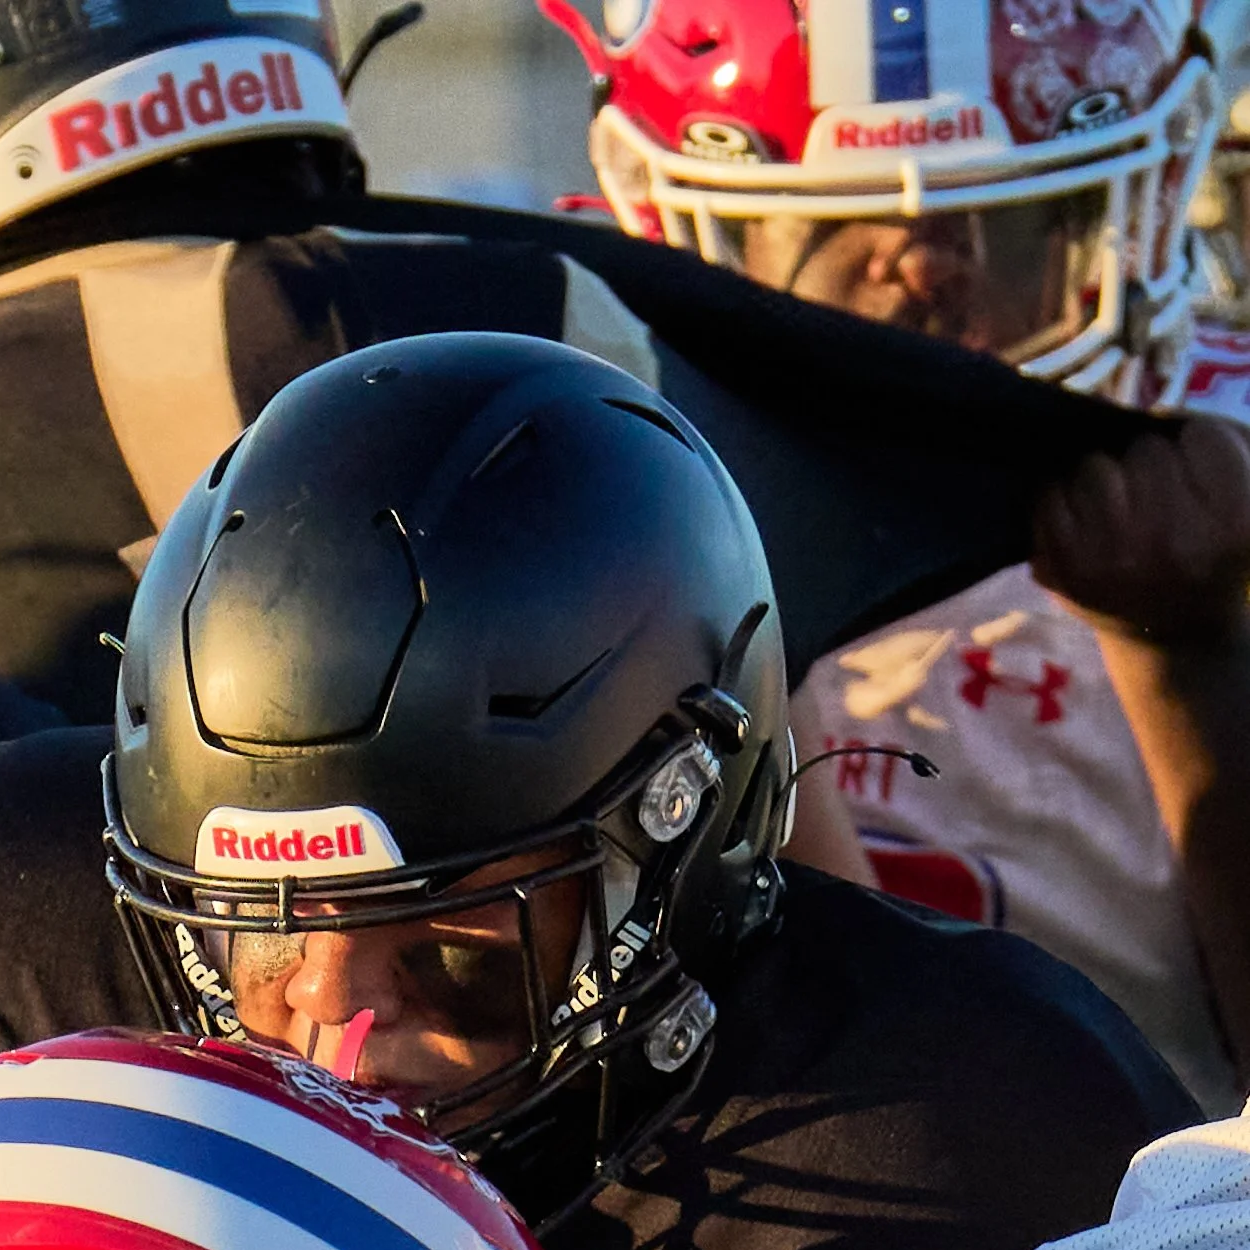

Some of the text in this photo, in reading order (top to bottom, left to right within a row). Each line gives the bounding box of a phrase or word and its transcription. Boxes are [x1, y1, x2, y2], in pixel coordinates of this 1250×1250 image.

[49, 52, 303, 172] Riddell
[835, 107, 982, 149] Riddell
[822, 735, 902, 802] RT
[211, 822, 365, 862] Riddell
[174, 922, 248, 1041] Riddel
[551, 920, 650, 1027] Ridell
